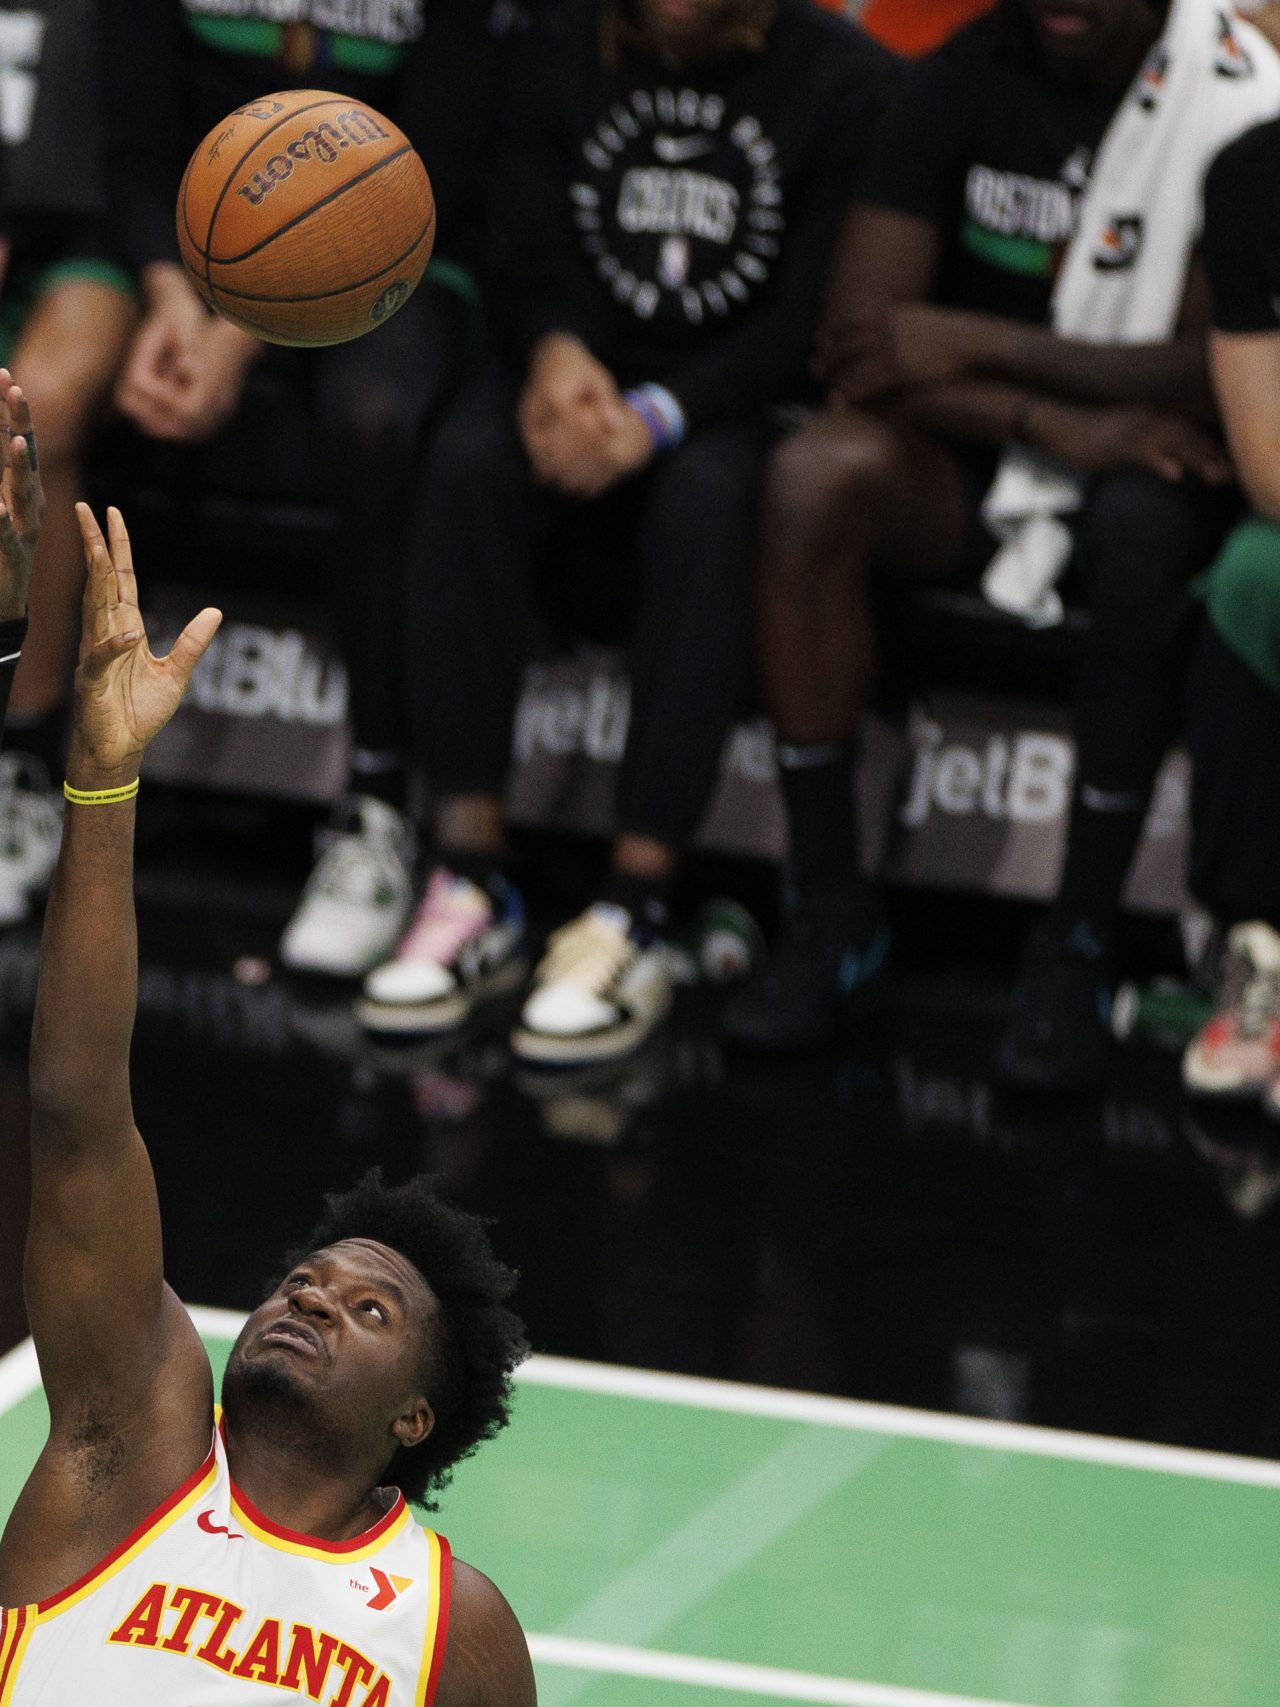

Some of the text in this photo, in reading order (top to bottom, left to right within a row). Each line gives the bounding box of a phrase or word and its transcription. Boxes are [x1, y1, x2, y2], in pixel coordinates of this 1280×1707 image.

[236, 109, 390, 206] Wilson
[901, 722, 1074, 825] jetB
[349, 1578, 369, 1593] the
[106, 1583, 393, 1707] ATLANTA
